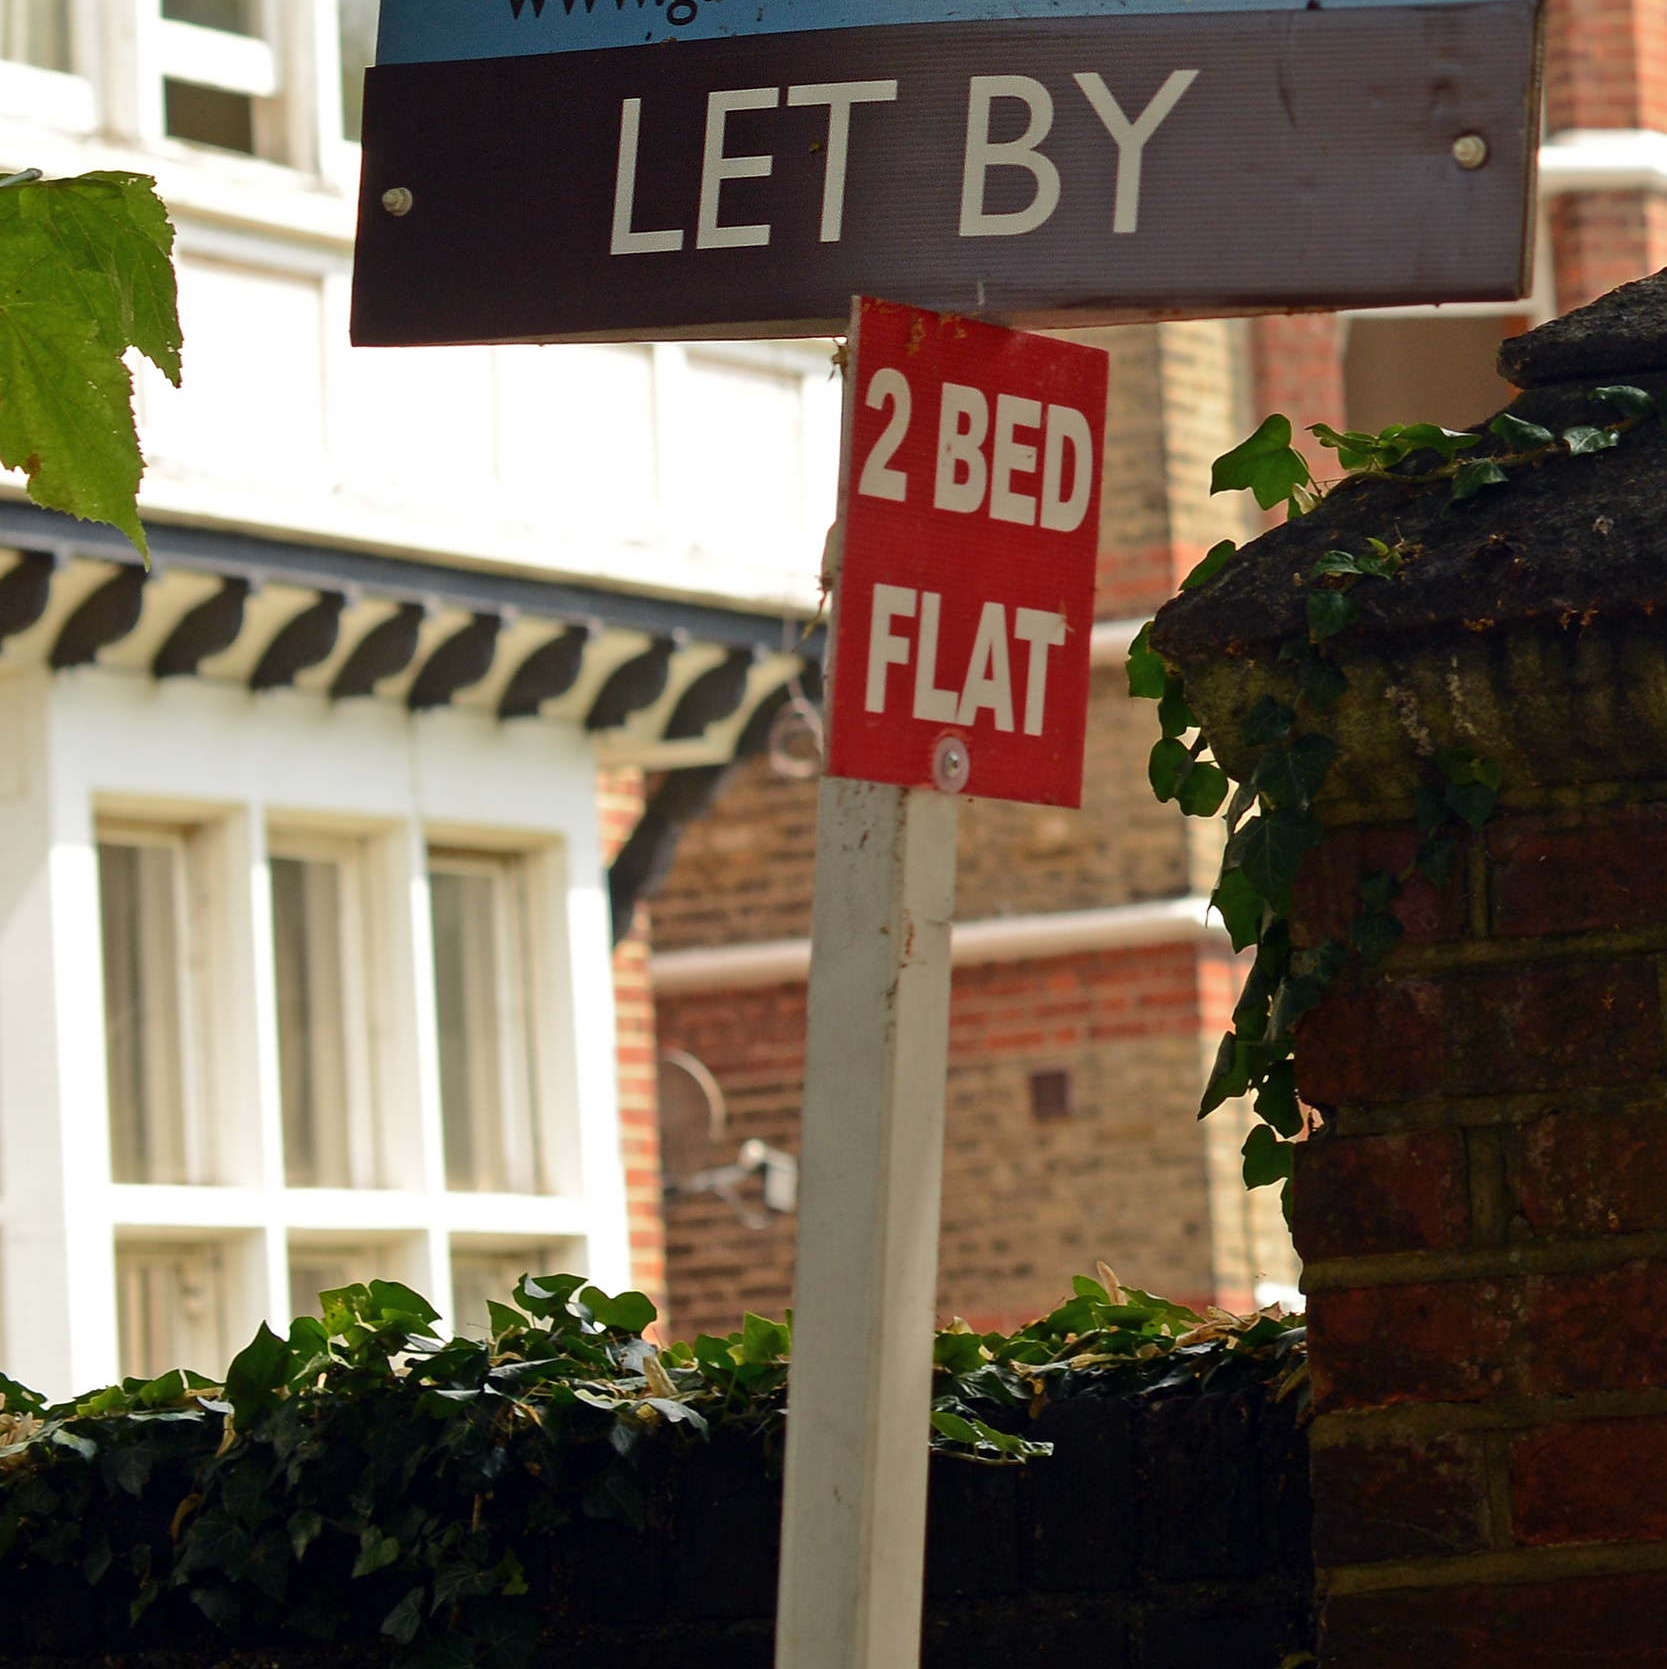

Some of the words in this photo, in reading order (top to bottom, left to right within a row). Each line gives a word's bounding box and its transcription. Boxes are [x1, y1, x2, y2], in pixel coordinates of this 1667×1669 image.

[609, 80, 897, 255] LET
[958, 70, 1199, 238] BY
[859, 367, 912, 502] 2
[934, 382, 1093, 532] BED
[865, 584, 1065, 736] FLAT
